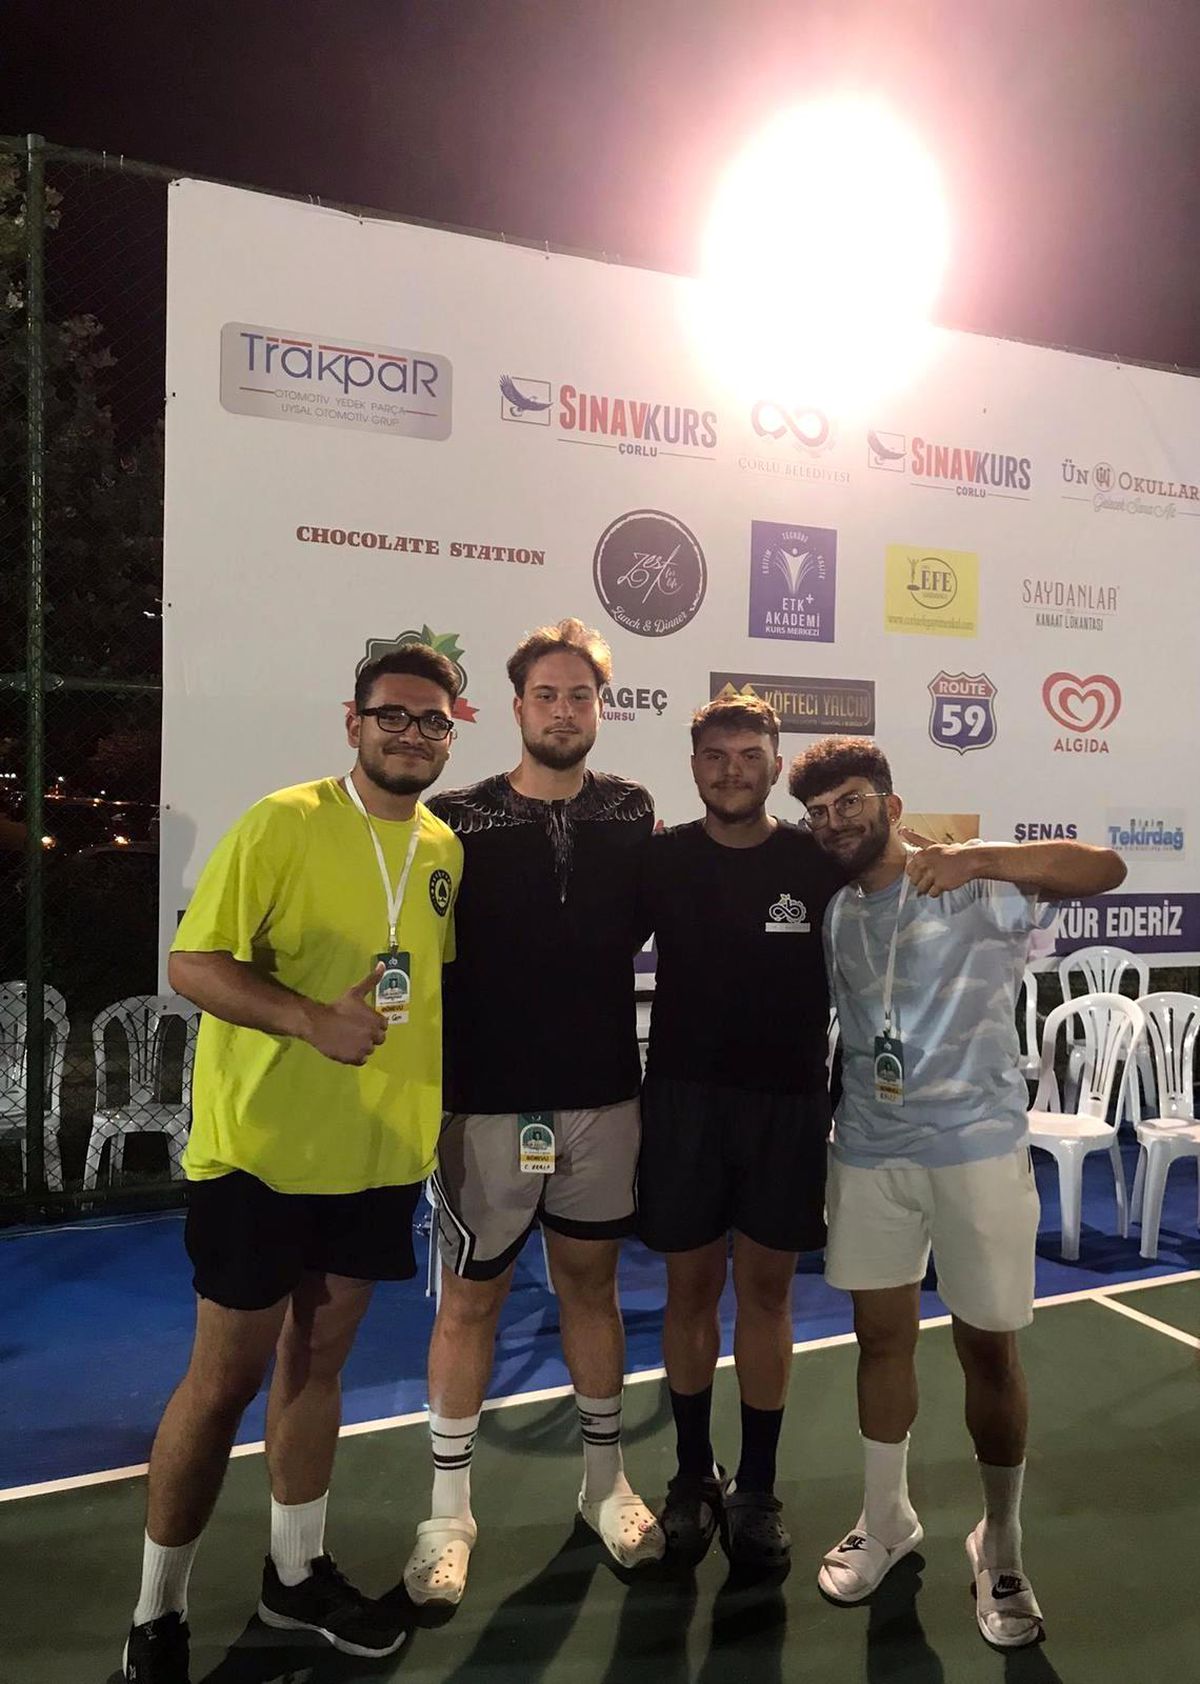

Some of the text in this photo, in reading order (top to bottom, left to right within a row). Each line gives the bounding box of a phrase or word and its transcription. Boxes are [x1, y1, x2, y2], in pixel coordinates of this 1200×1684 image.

[559, 385, 718, 449] SINAVKURS
[618, 443, 658, 457] ÇORLU
[911, 437, 1032, 491] SINAVKURS
[296, 526, 546, 566] CHOCOLATE STATION
[921, 570, 952, 592] EFE
[1022, 579, 1117, 611] SAYDANLAR
[939, 681, 986, 696] ROUTE
[941, 704, 986, 737] 59
[1054, 738, 1110, 754] ALGIDA
[1108, 826, 1184, 850] Tekirdağ
[1106, 900, 1183, 938] EDERİZ
